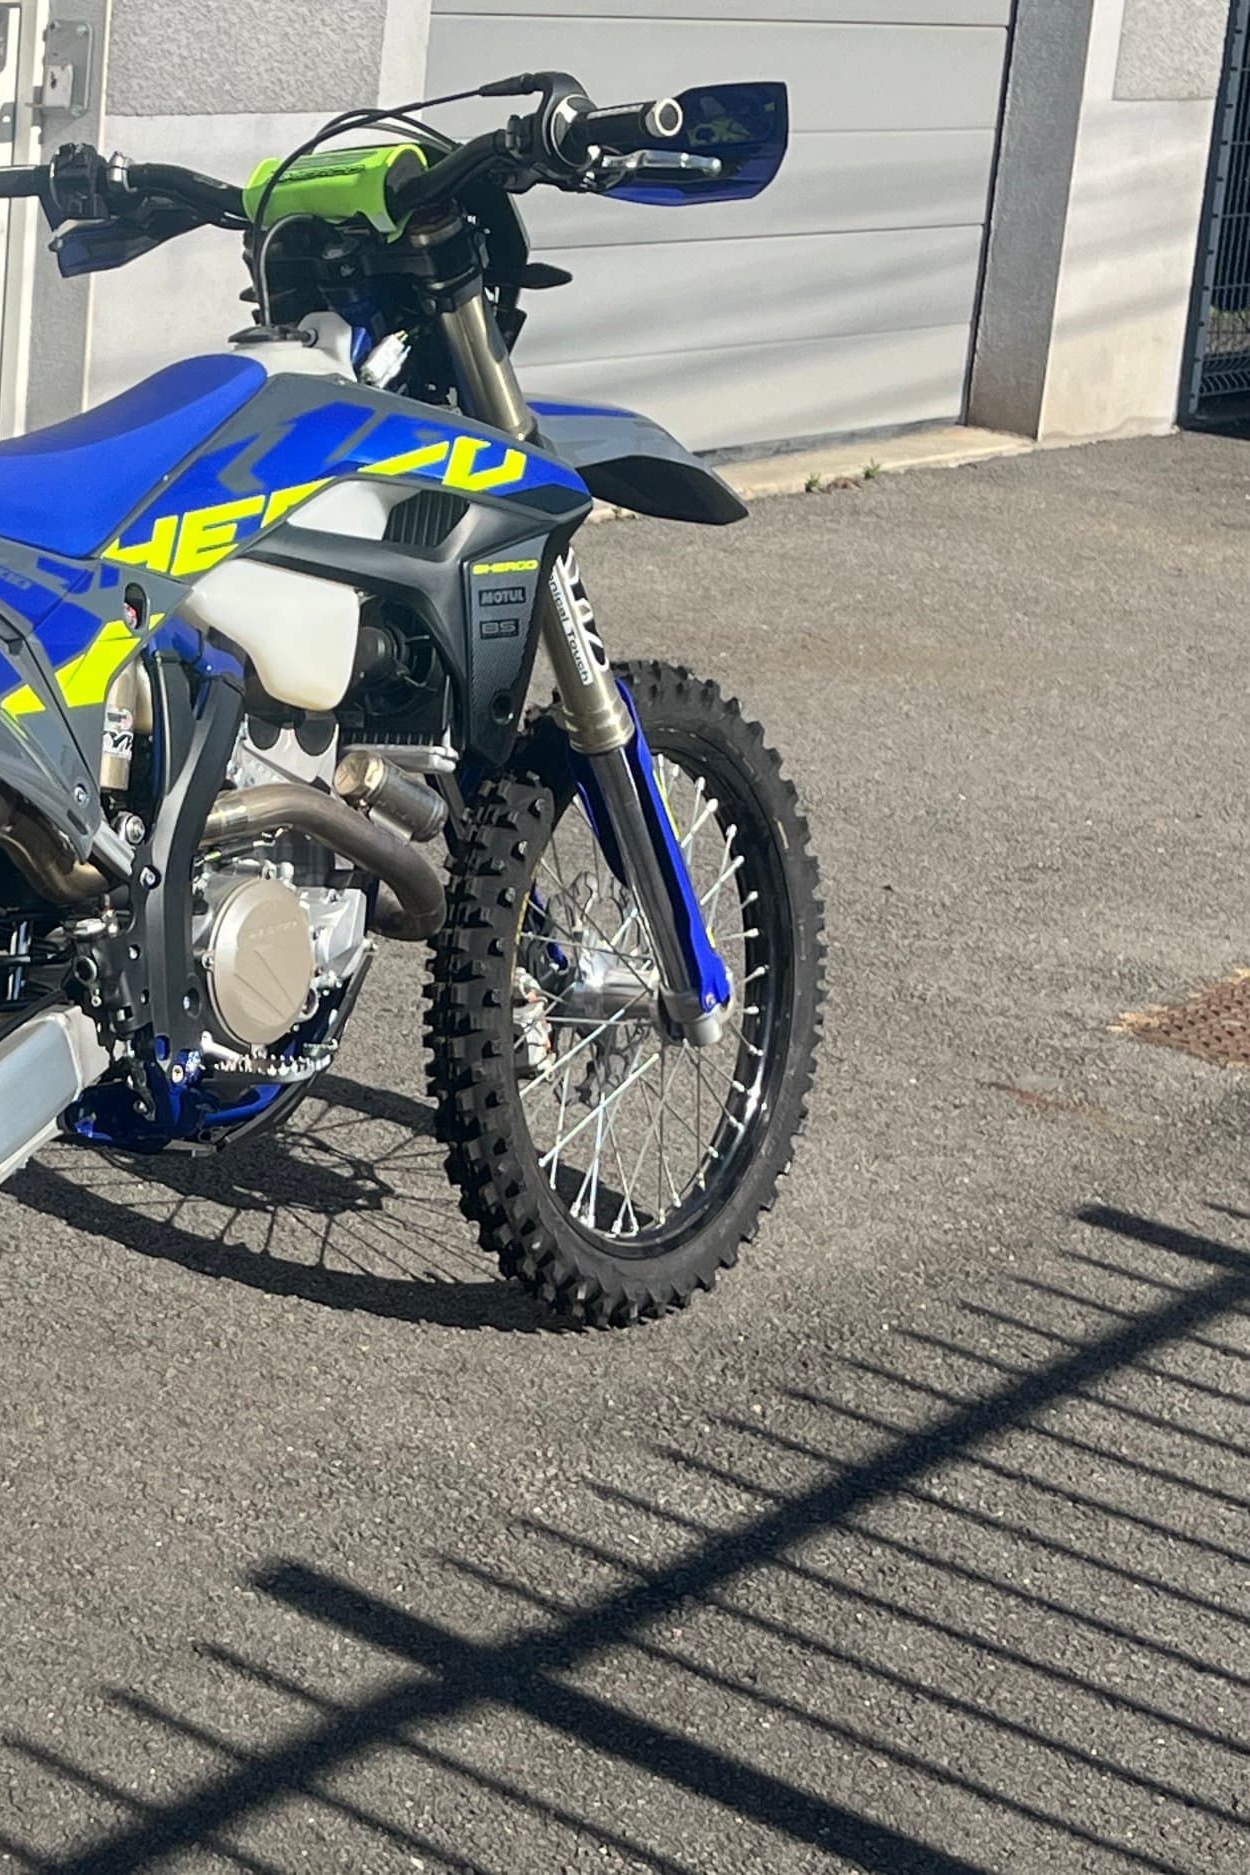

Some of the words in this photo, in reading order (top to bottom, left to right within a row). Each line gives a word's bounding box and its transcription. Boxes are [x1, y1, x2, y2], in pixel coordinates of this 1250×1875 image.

[472, 560, 539, 575] SHERCO
[481, 588, 524, 605] MOTUL
[566, 628, 590, 683] Touch
